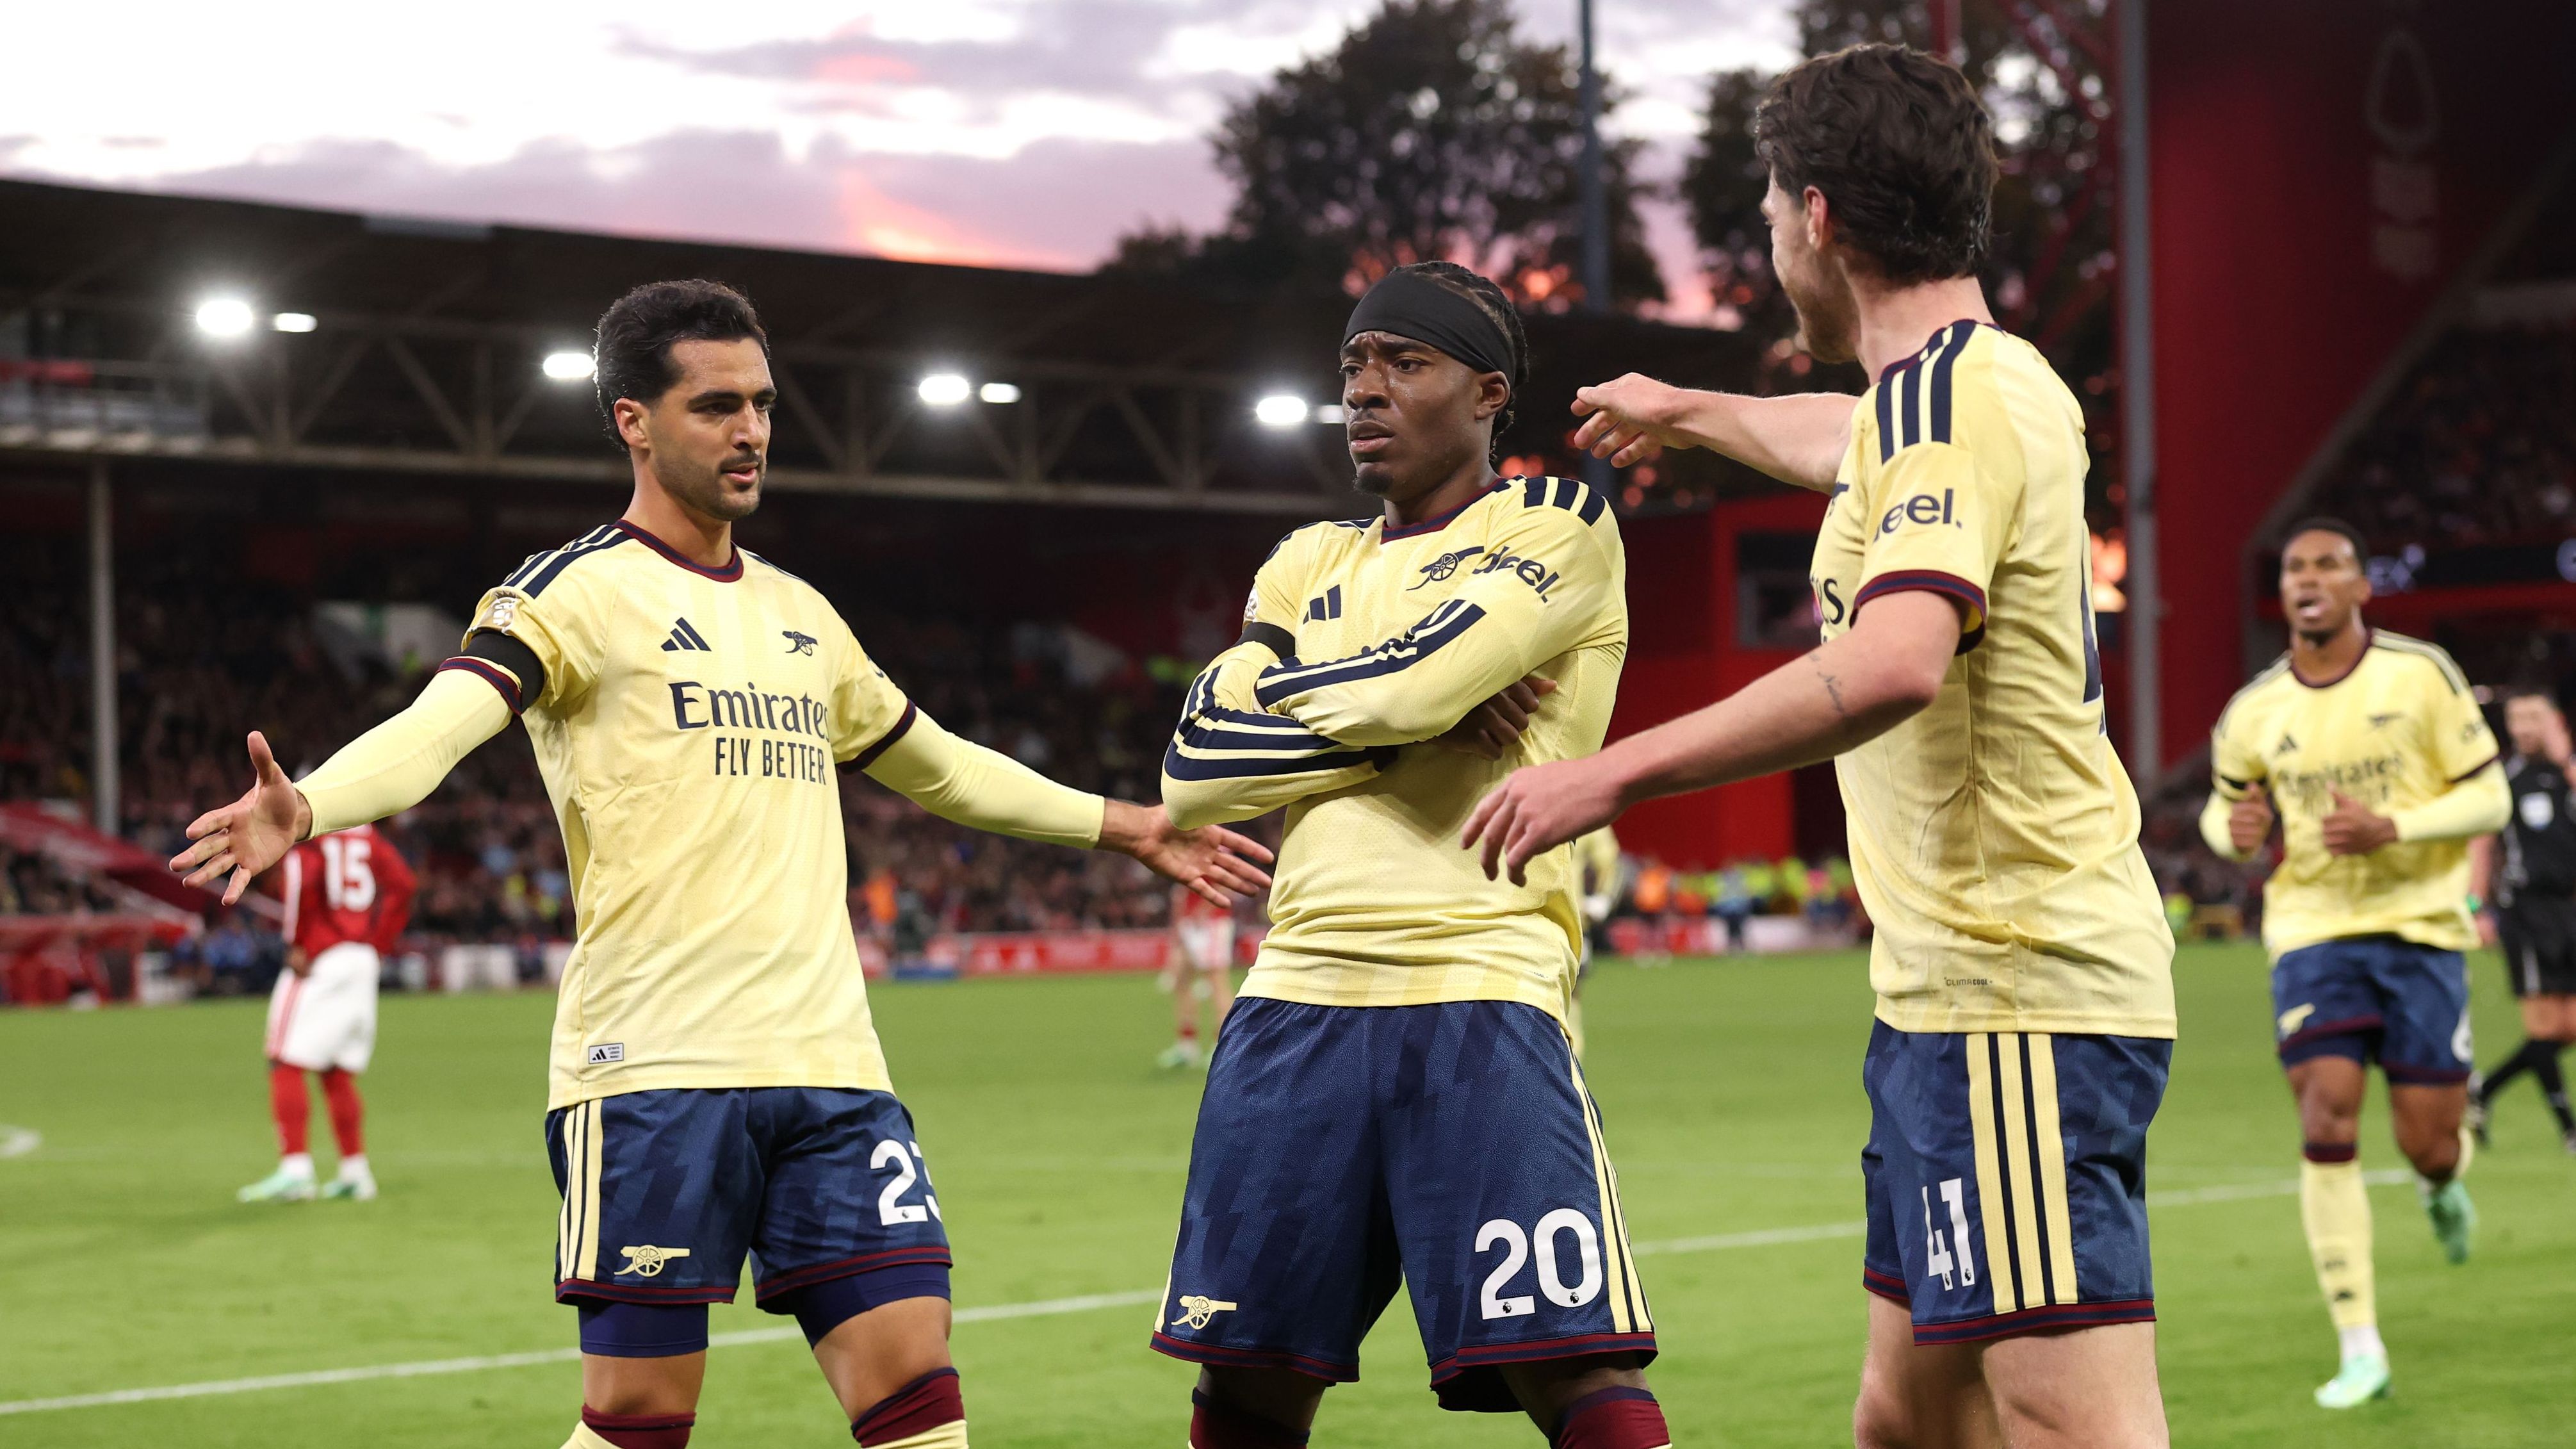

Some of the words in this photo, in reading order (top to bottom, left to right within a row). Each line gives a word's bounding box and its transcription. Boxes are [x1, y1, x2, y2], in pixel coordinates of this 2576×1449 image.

[715, 737, 751, 776] FLY
[762, 739, 827, 785] BETTER
[322, 837, 377, 912] 15
[1475, 1208, 1602, 1320] 20
[1922, 1178, 1975, 1291] 41
